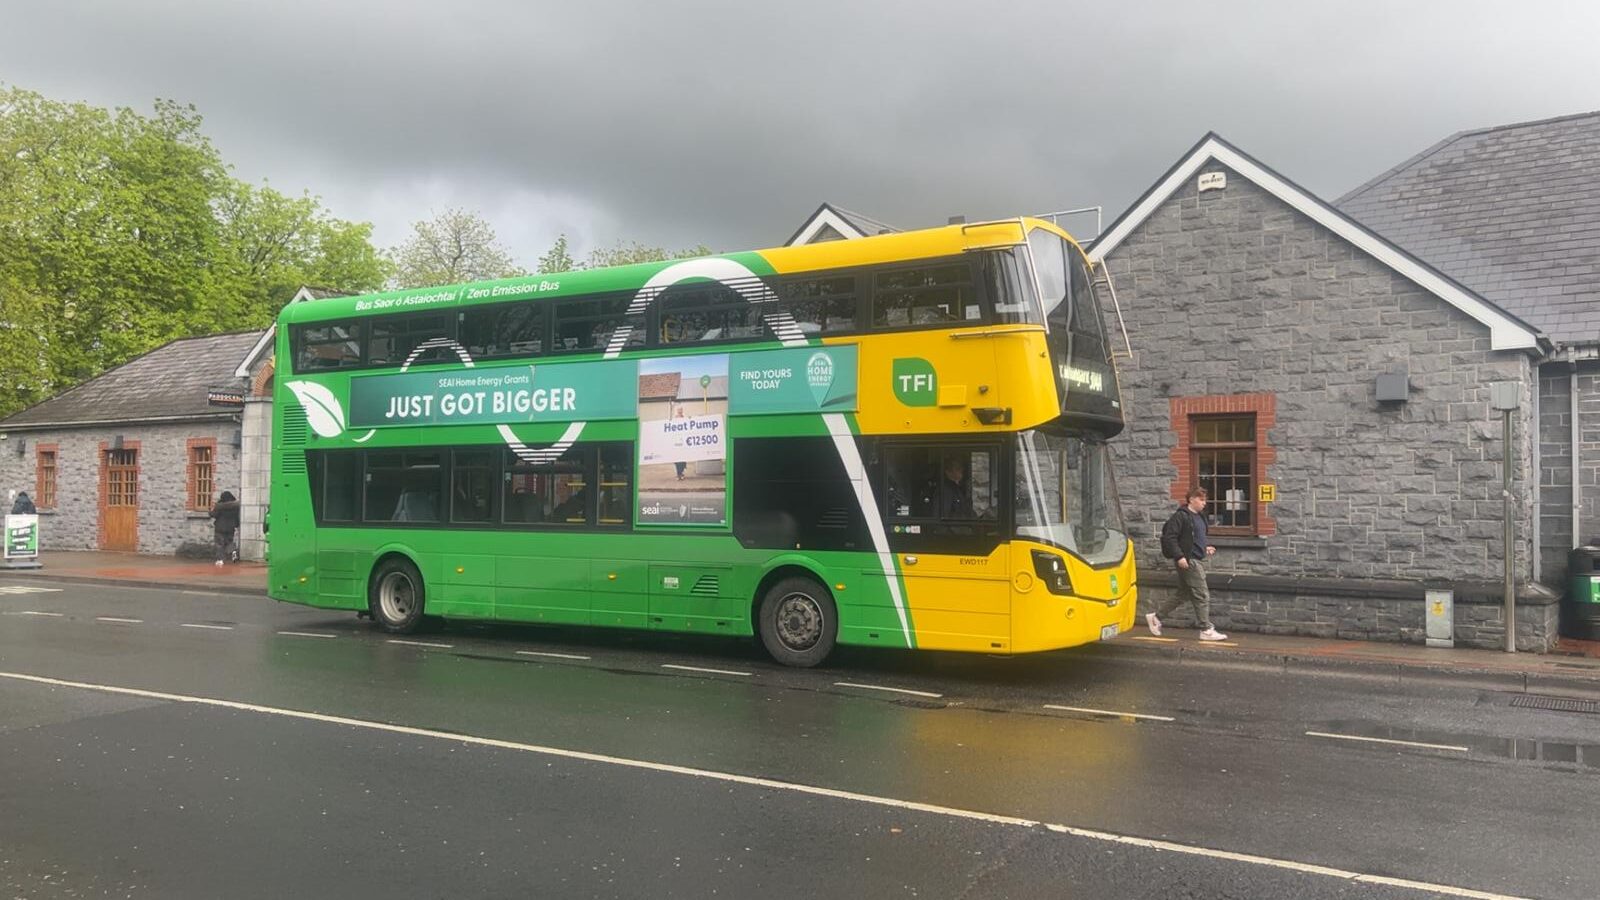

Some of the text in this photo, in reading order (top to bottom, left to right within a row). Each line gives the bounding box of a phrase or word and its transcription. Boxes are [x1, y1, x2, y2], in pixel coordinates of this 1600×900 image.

[467, 280, 560, 300] Zero Emission Bus
[355, 300, 372, 311] Bus
[373, 298, 395, 309] Saor
[740, 368, 792, 380] FIND YOURS
[807, 366, 832, 375] HOME
[438, 374, 529, 388] SEAI Home Energy Grants
[752, 379, 780, 390] TODAY
[899, 373, 933, 393] TFI
[385, 387, 577, 418] JUST GOT BIGGER
[664, 420, 719, 433] Heat Pump
[641, 502, 660, 515] seai
